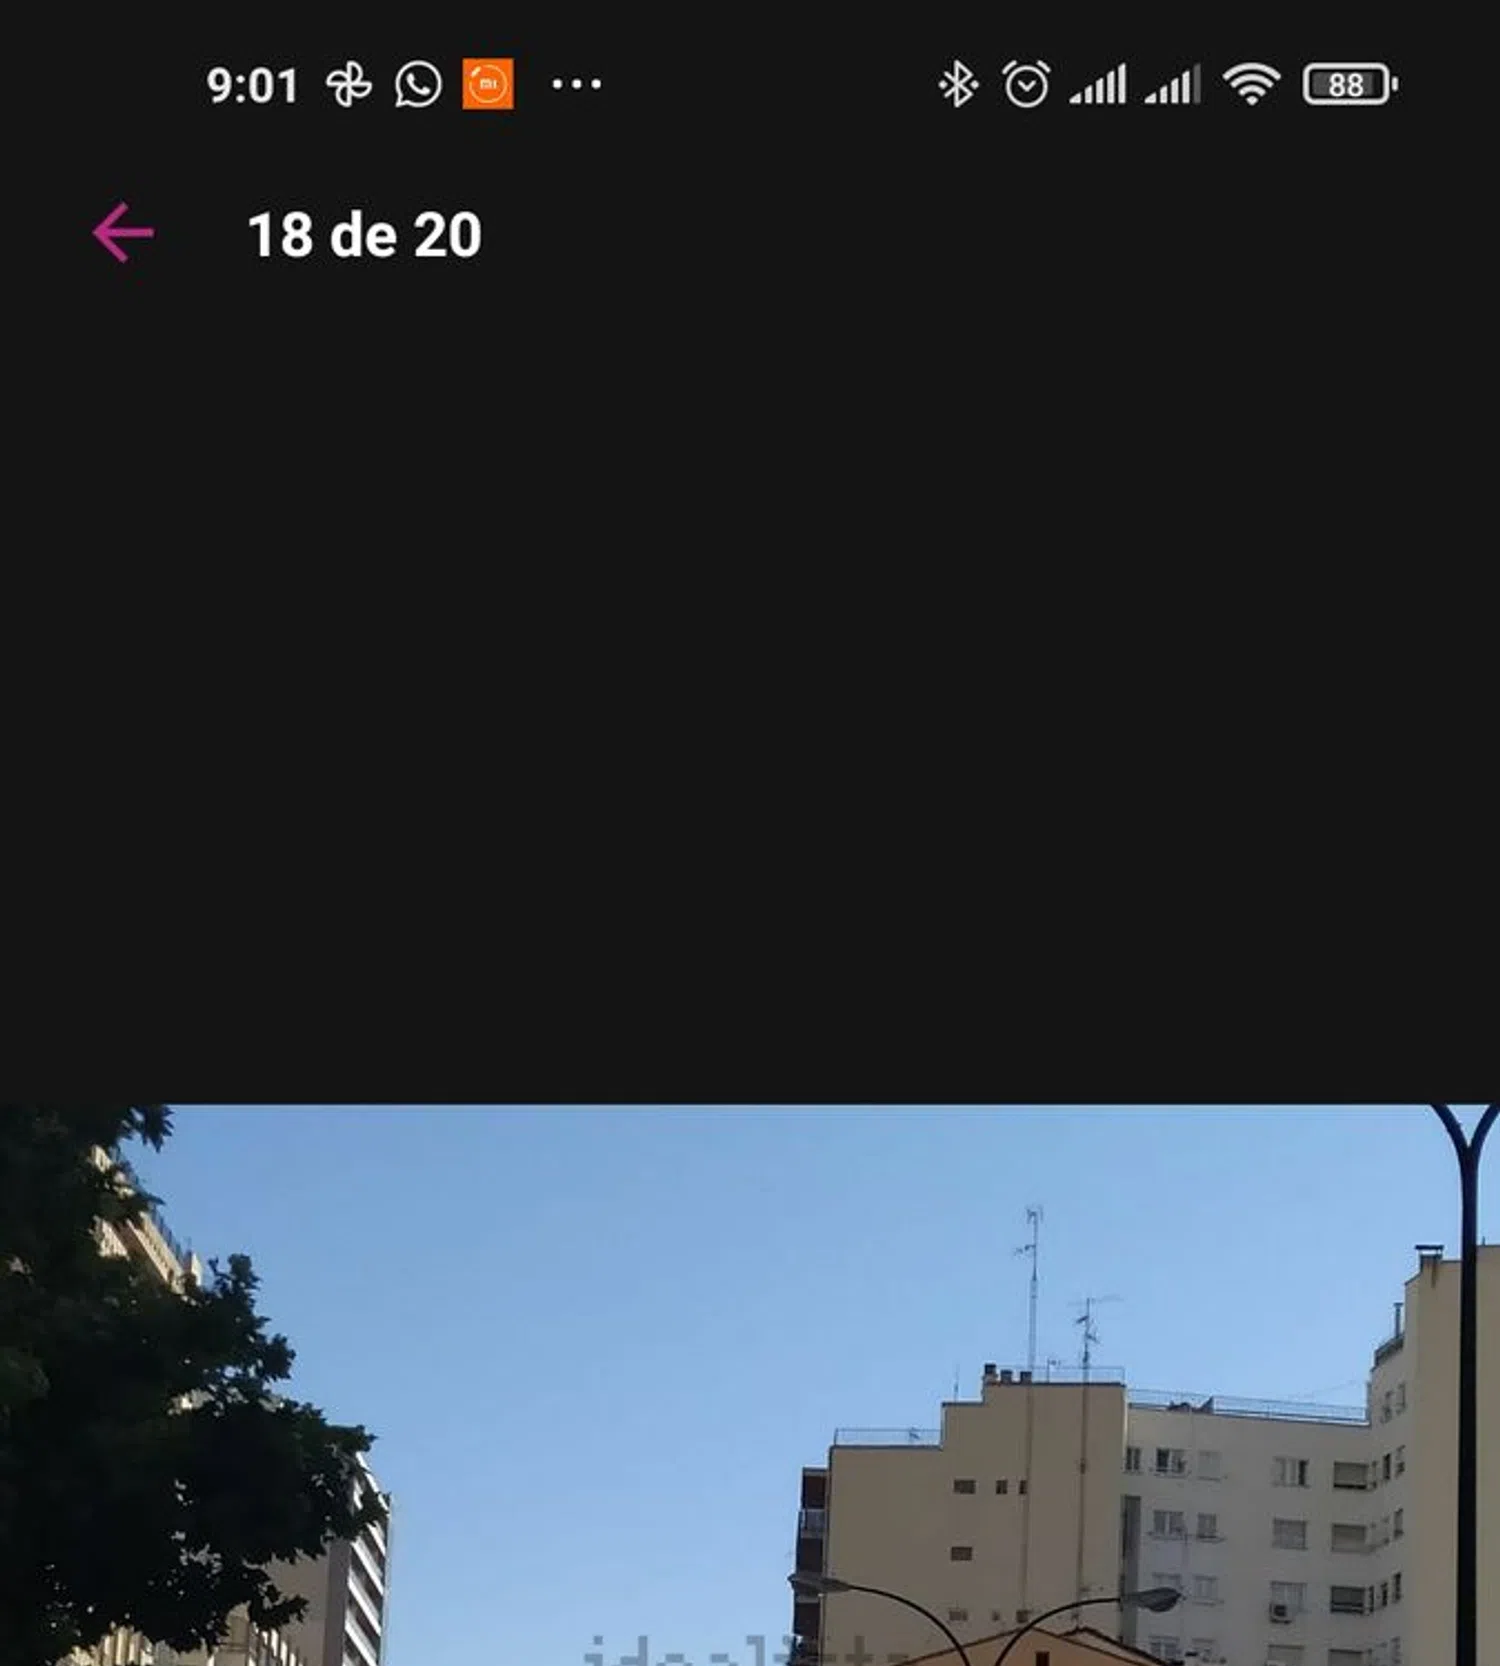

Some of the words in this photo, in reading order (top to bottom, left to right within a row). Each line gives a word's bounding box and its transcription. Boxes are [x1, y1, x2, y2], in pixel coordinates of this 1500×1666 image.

[207, 67, 295, 103] 9:01
[1329, 72, 1364, 97] 88
[249, 211, 313, 258] 18
[330, 209, 397, 258] de
[414, 211, 481, 258] 20
